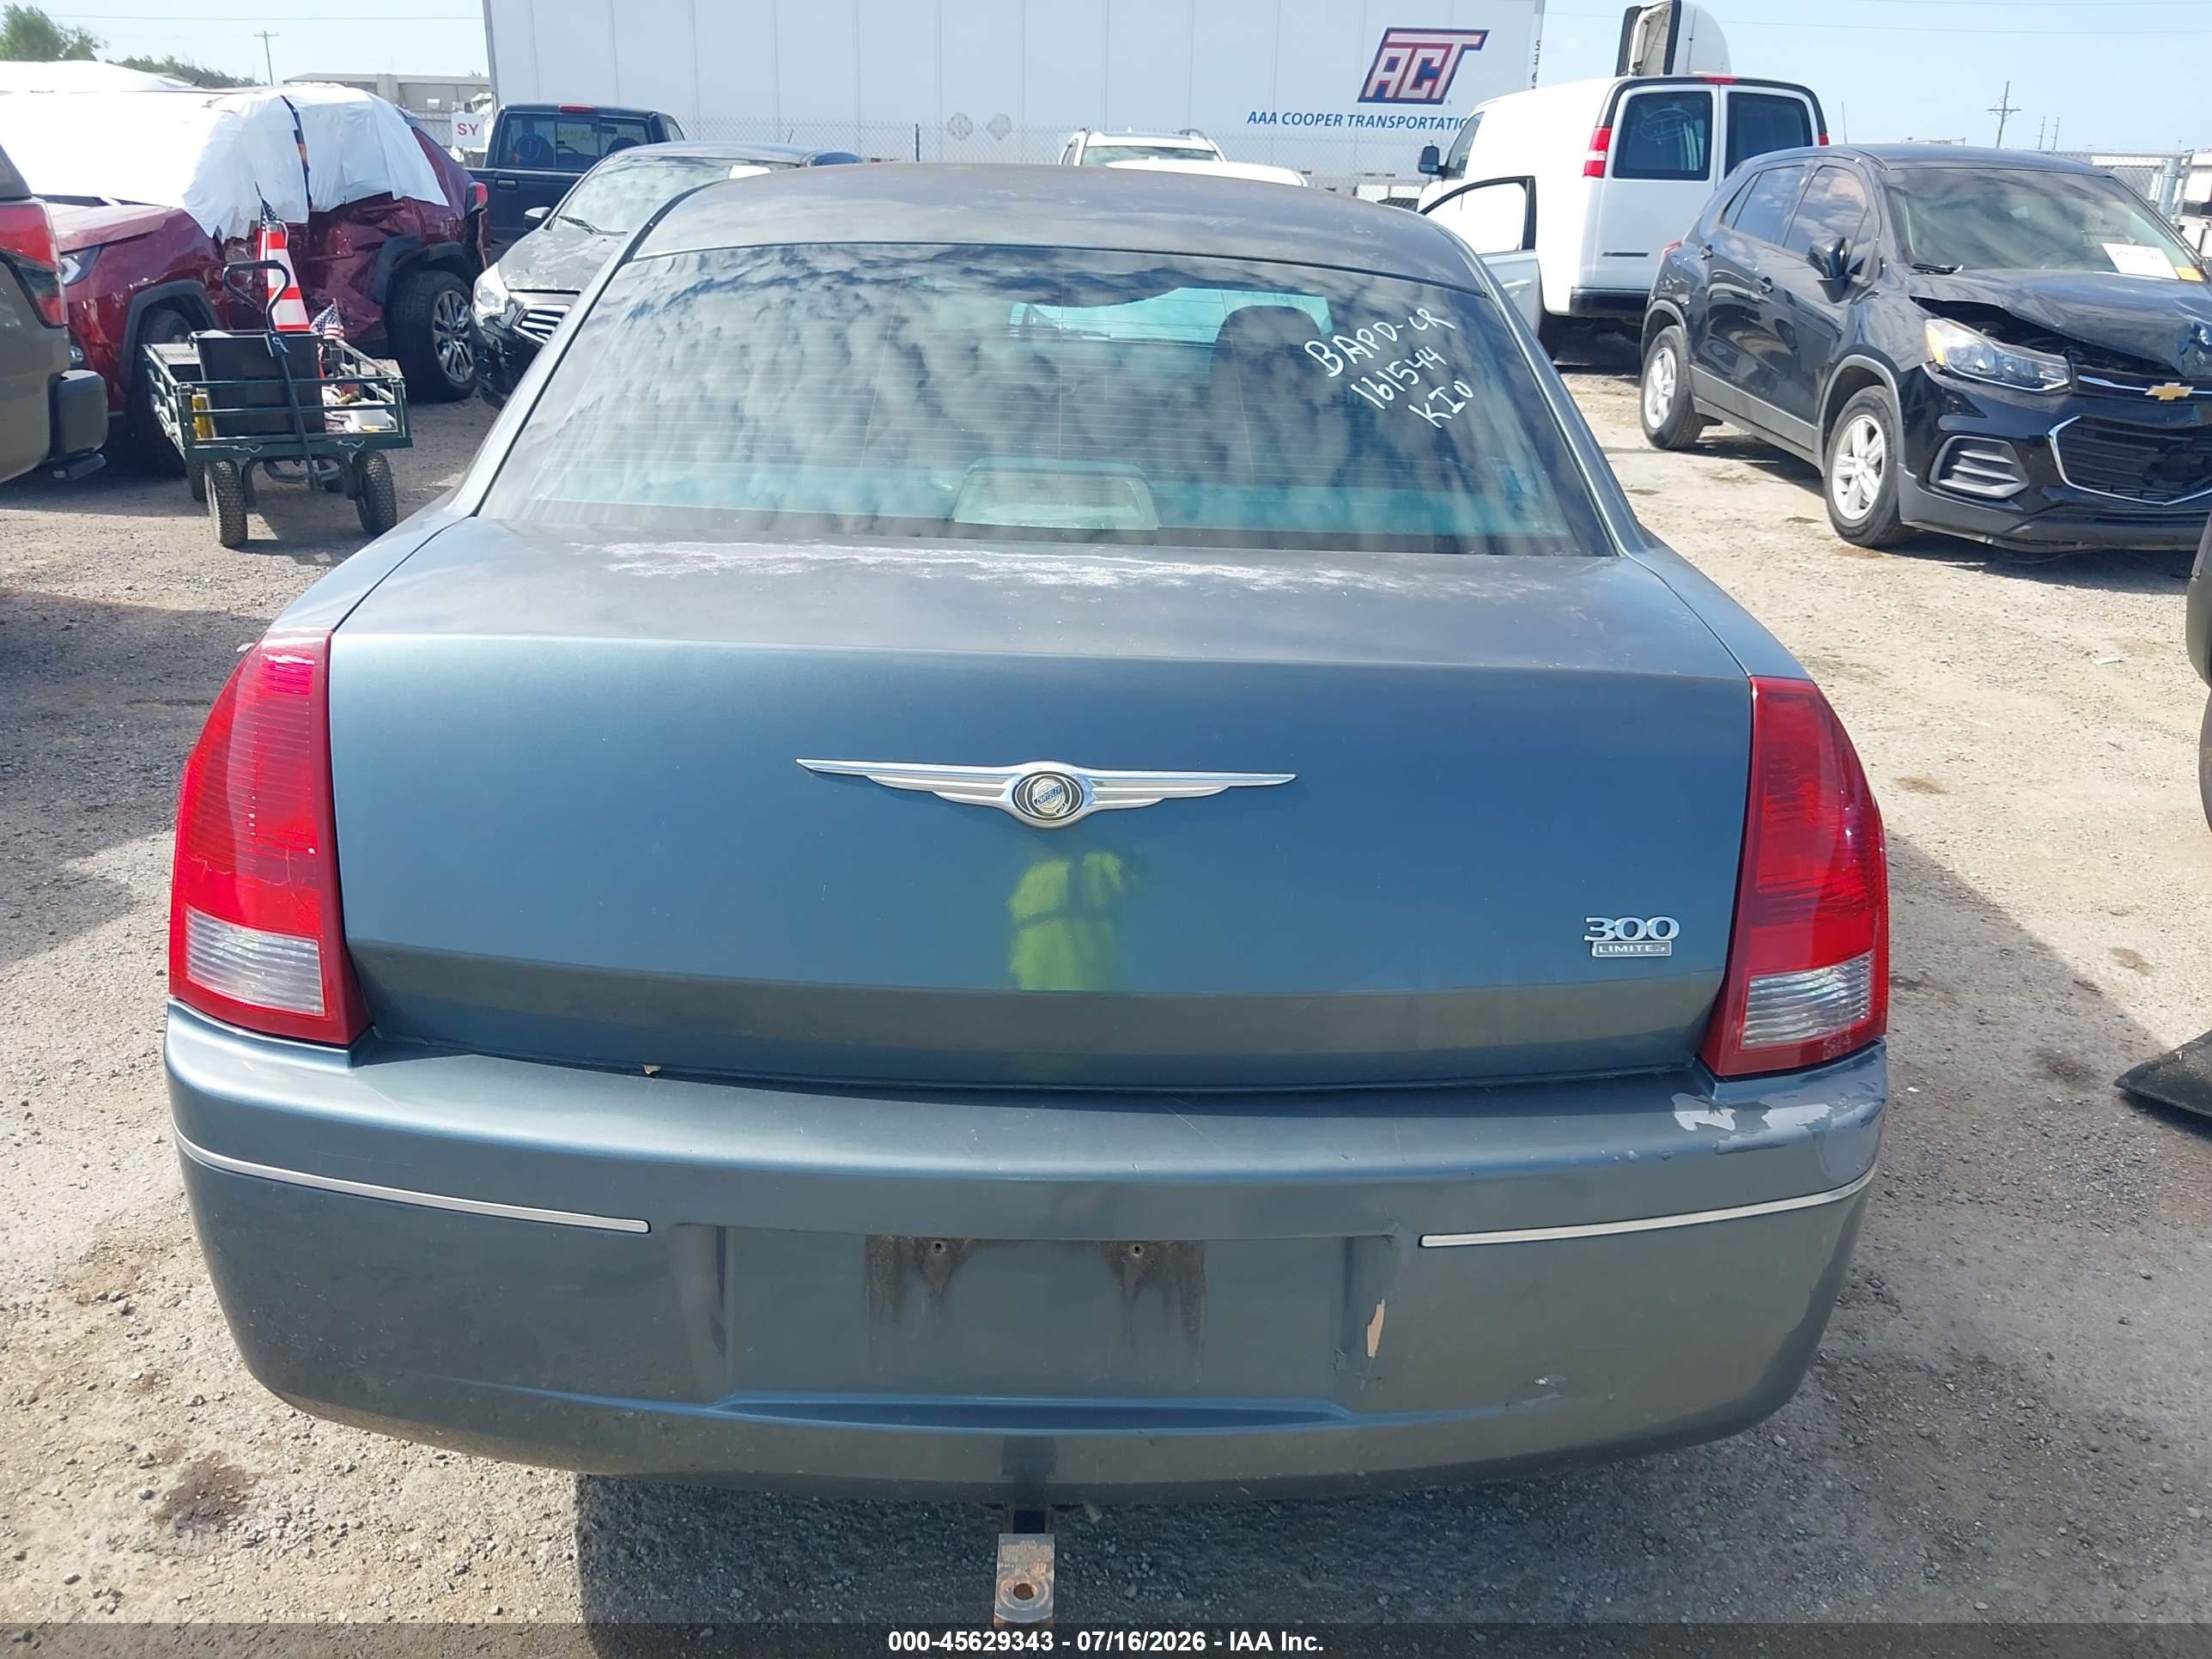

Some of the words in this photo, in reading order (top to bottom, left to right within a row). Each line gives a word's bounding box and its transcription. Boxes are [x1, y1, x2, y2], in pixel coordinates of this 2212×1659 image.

[1363, 31, 1485, 101] ACT
[456, 122, 479, 137] SY
[1246, 111, 1278, 125] AAA
[1281, 112, 1343, 128] COOPER
[1349, 345, 1448, 410] 161544
[1583, 915, 1680, 942] 300
